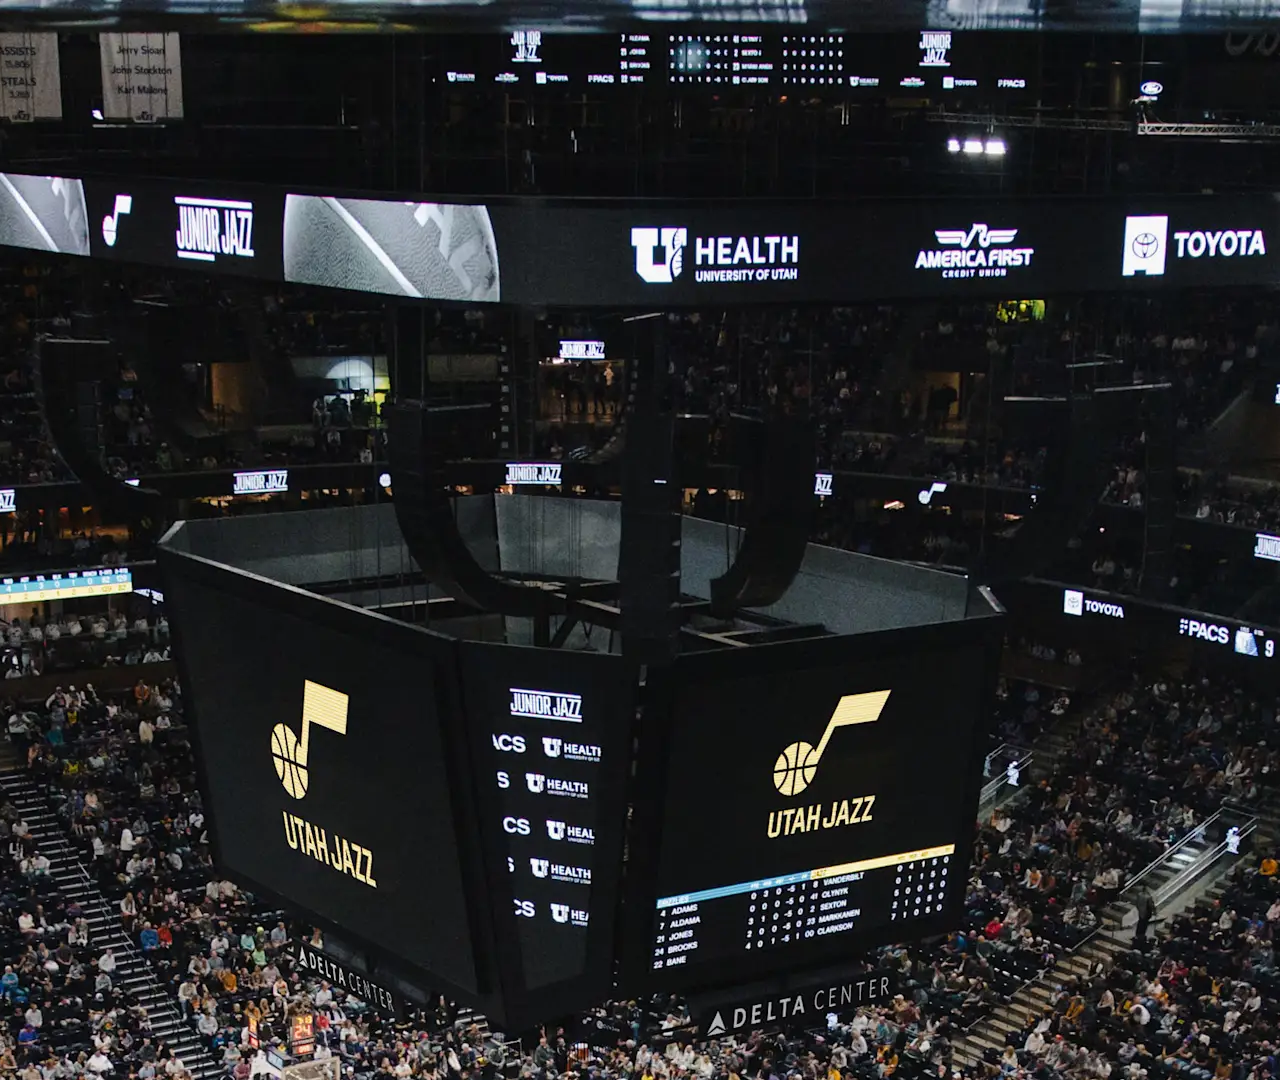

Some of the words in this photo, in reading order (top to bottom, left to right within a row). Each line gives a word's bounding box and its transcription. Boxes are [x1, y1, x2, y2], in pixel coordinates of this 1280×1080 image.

[118, 46, 139, 55] Jerry
[142, 46, 166, 54] Sloan
[920, 34, 951, 49] JUNIOR
[0, 47, 36, 56] ASSISTS
[924, 49, 946, 62] JAZZ
[112, 66, 131, 74] John
[1, 78, 36, 86] STEALS
[138, 86, 167, 94] Malone
[177, 205, 219, 252] JUNIOR
[221, 206, 253, 257] JAZZ
[696, 236, 799, 265] HEALTH
[1174, 231, 1265, 257] TOYOTA
[916, 250, 987, 268] AMERICA
[989, 249, 1034, 266] FIRST
[696, 269, 753, 281] UNIVERSITY
[756, 269, 769, 279] OF
[771, 268, 797, 279] UTAH
[234, 475, 264, 490] JUNIOR
[266, 473, 287, 489] JAZZ
[506, 467, 537, 483] JUNIOR
[538, 466, 561, 482] JAZZ
[815, 477, 832, 492] AZZ
[1085, 600, 1124, 618] TOYOTA
[1189, 620, 1228, 644] PACS
[1266, 641, 1274, 657] 9
[510, 693, 551, 715] JUNIOR
[553, 698, 581, 718] JAZZ
[547, 779, 588, 793] HEALTH
[768, 803, 820, 838] UTAH
[822, 795, 875, 829] JAZZ
[568, 826, 595, 839] HEAL
[282, 811, 329, 864] UTAH
[330, 836, 377, 888] JAZZ
[551, 864, 591, 879] HEALTH
[671, 904, 698, 915] ADAMS
[823, 872, 864, 886] VANDERBILT
[670, 916, 700, 929] ALDAMA
[821, 888, 848, 899] OLYNYK
[669, 930, 693, 941] JONES
[820, 900, 847, 911] SEXTON
[655, 948, 664, 956] 24
[668, 941, 698, 954] BROOKS
[819, 909, 860, 923] MARKKANEN
[666, 956, 686, 966] BANE
[805, 930, 814, 938] 00
[817, 922, 853, 935] CLARKSON
[309, 952, 346, 986] DELTA
[348, 972, 394, 1012] CENTER
[733, 996, 805, 1030] DELTA
[814, 976, 890, 1011] CENTER
